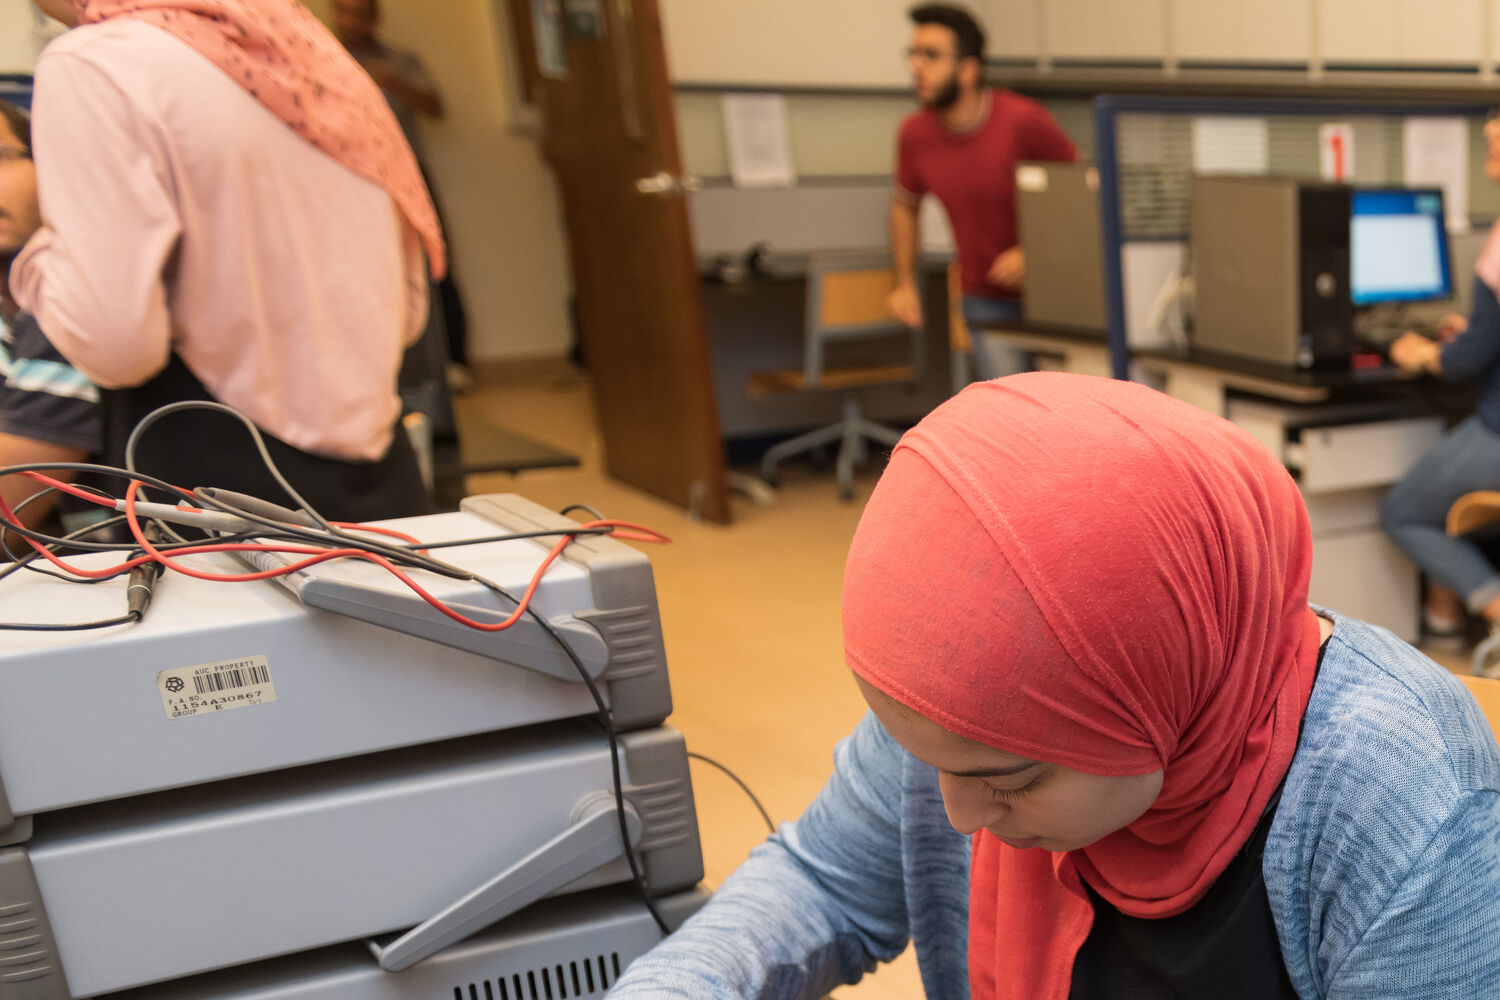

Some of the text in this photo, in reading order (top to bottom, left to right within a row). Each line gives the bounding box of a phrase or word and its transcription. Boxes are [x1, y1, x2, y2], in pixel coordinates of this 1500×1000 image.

[195, 660, 255, 676] AUC PROPERTY
[172, 709, 198, 718] GROUP
